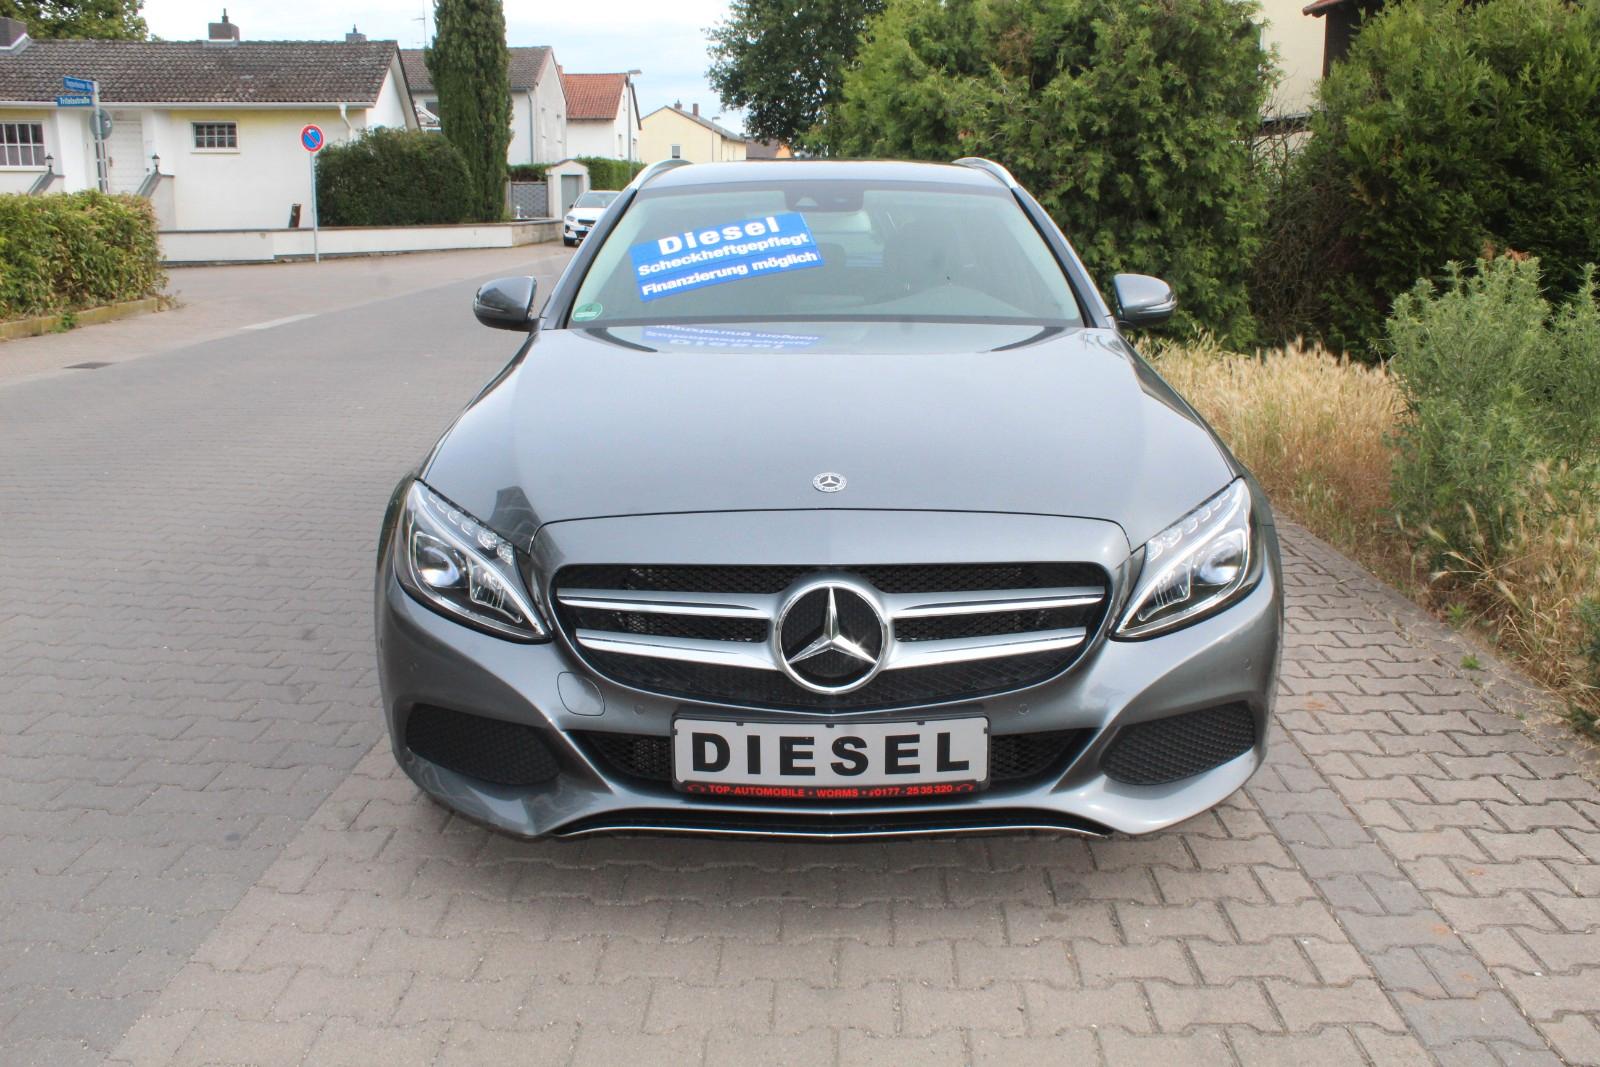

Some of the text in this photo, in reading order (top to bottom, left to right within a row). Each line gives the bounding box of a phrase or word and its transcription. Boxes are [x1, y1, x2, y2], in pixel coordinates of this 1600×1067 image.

[638, 233, 809, 276] Scheckheftgepflegt
[657, 216, 780, 256] Diesel
[641, 251, 818, 296] Finanzierung möglich
[691, 732, 970, 777] DIESEL
[708, 784, 805, 798] TOP-AUTOMOBILE
[816, 788, 859, 799] WORMS
